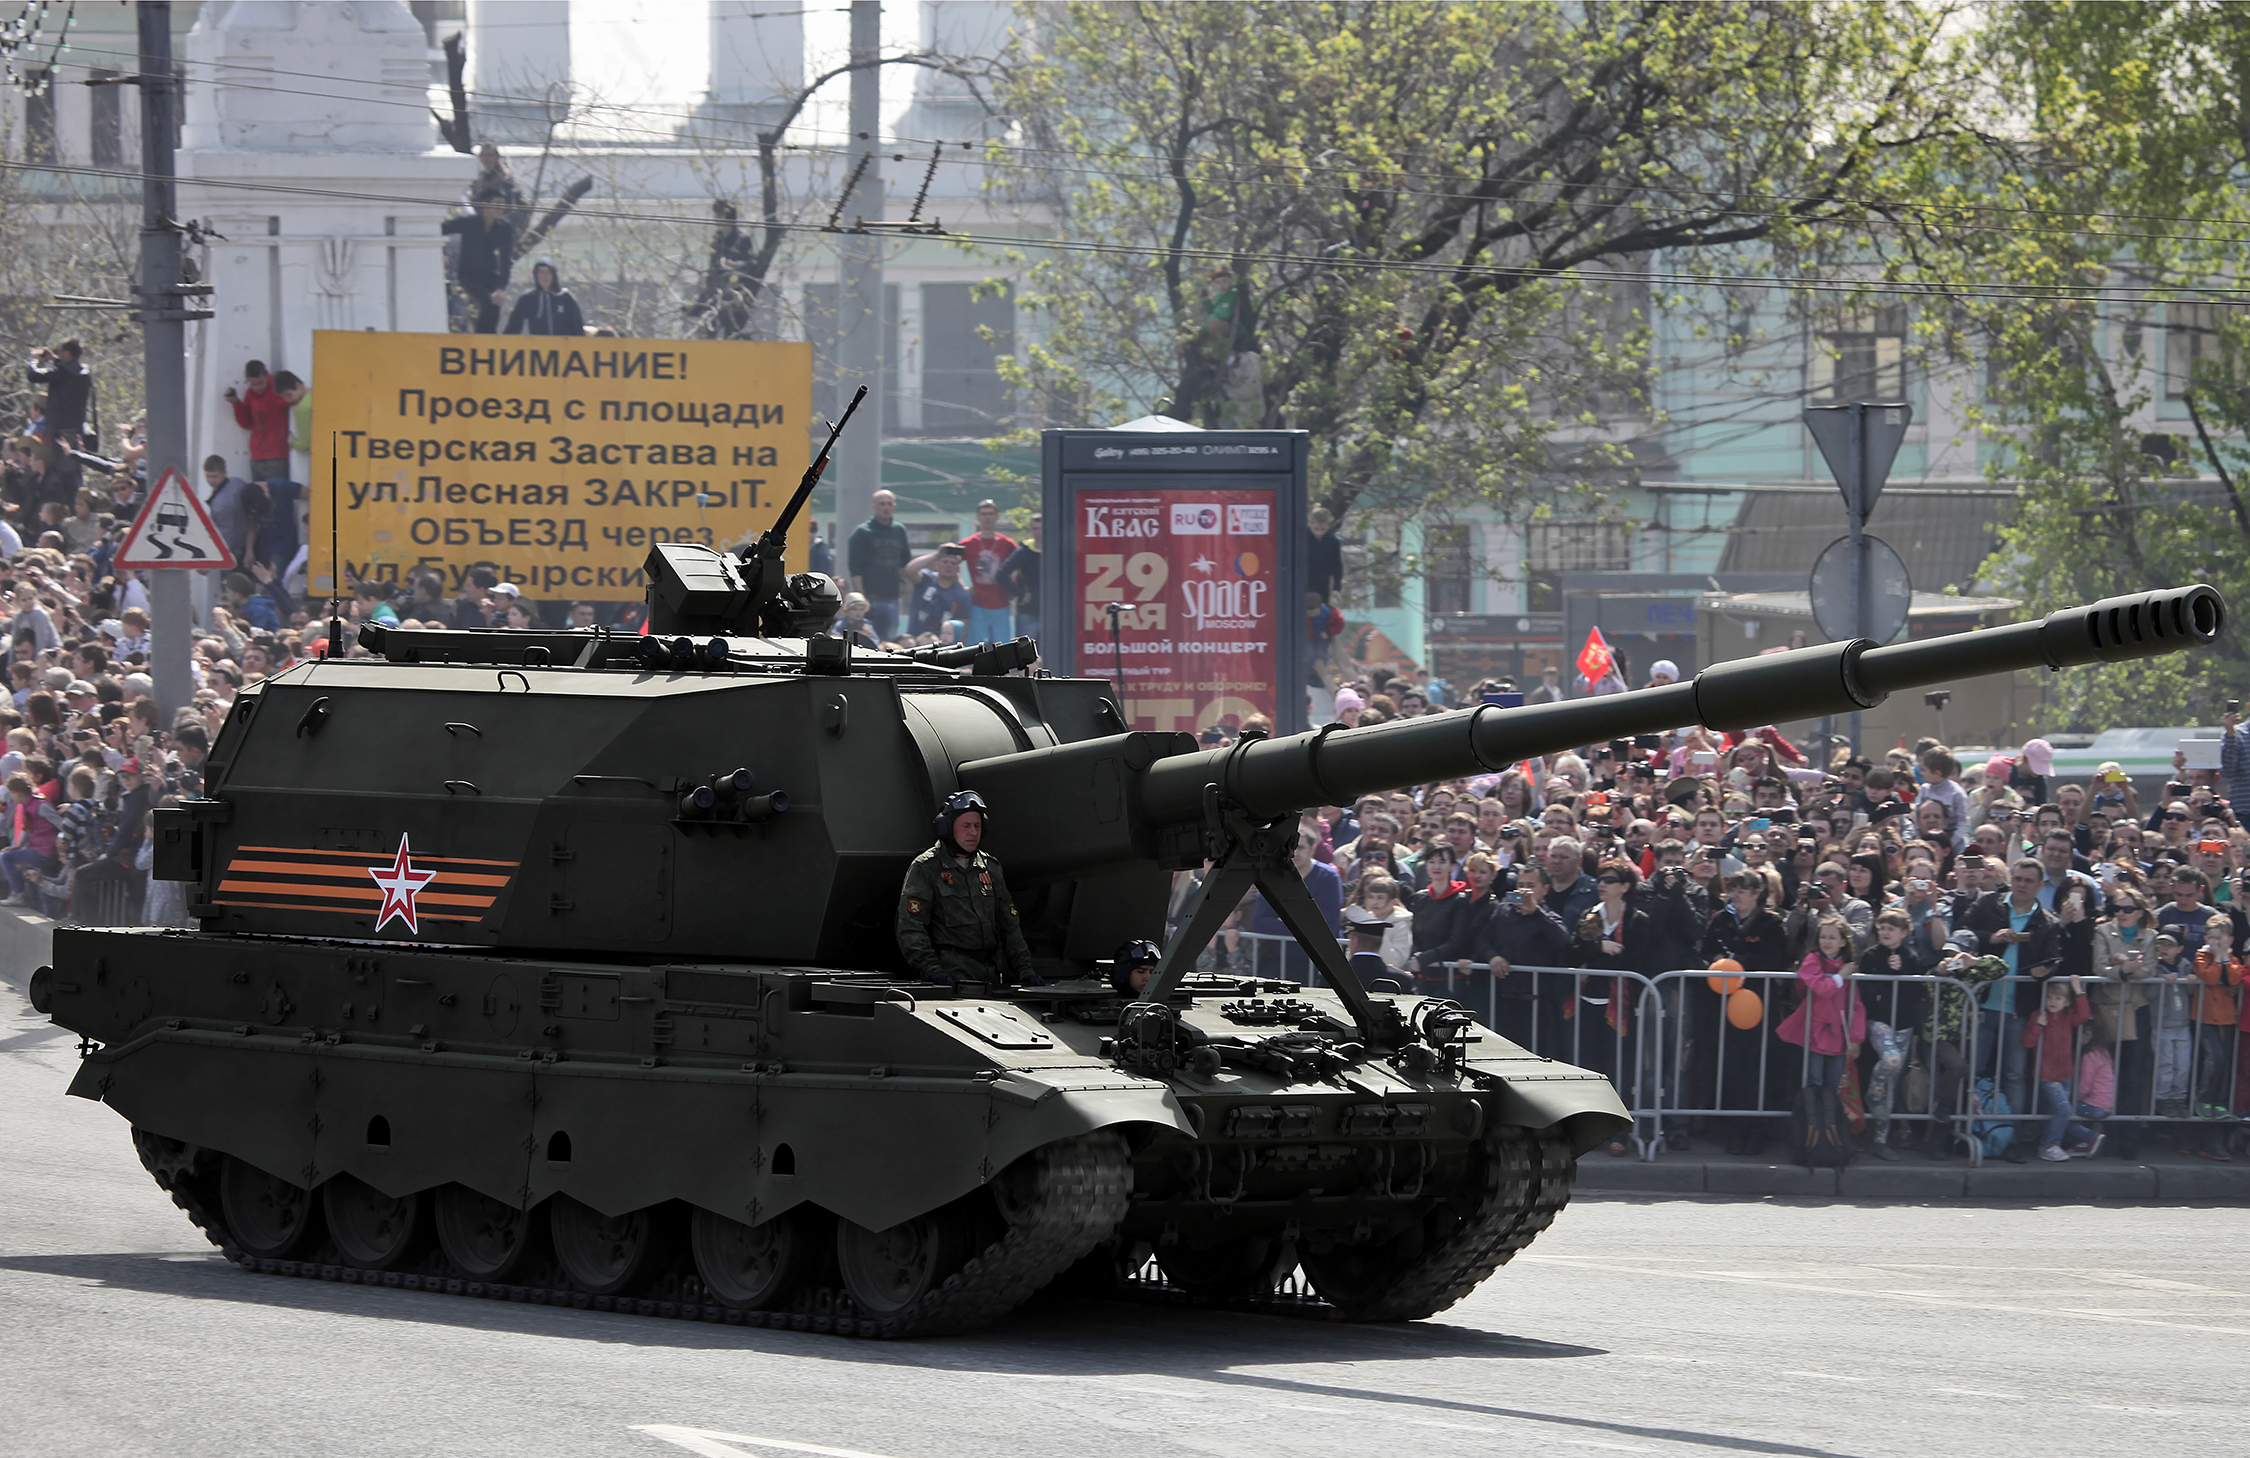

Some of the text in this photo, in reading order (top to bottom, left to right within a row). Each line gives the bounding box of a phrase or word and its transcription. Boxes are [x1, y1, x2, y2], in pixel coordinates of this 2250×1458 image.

[439, 347, 688, 380] ВНИМАНИЕ!
[398, 389, 784, 428] Проезд с площади
[342, 431, 778, 468] Тверская Застава на
[347, 476, 773, 511] ул.Лесная ЗАКРЫТ.
[410, 518, 588, 552] ОБЪЕЗД
[602, 525, 714, 548] через
[1175, 513, 1196, 525] RU
[1085, 552, 1169, 601] 29
[1085, 603, 1167, 631] МАЯ
[1205, 620, 1257, 629] MOSCOW
[1084, 639, 1268, 655] БОЛЬШОЙ КОНЦЕРТ
[1139, 682, 1182, 693] ТРУДУ
